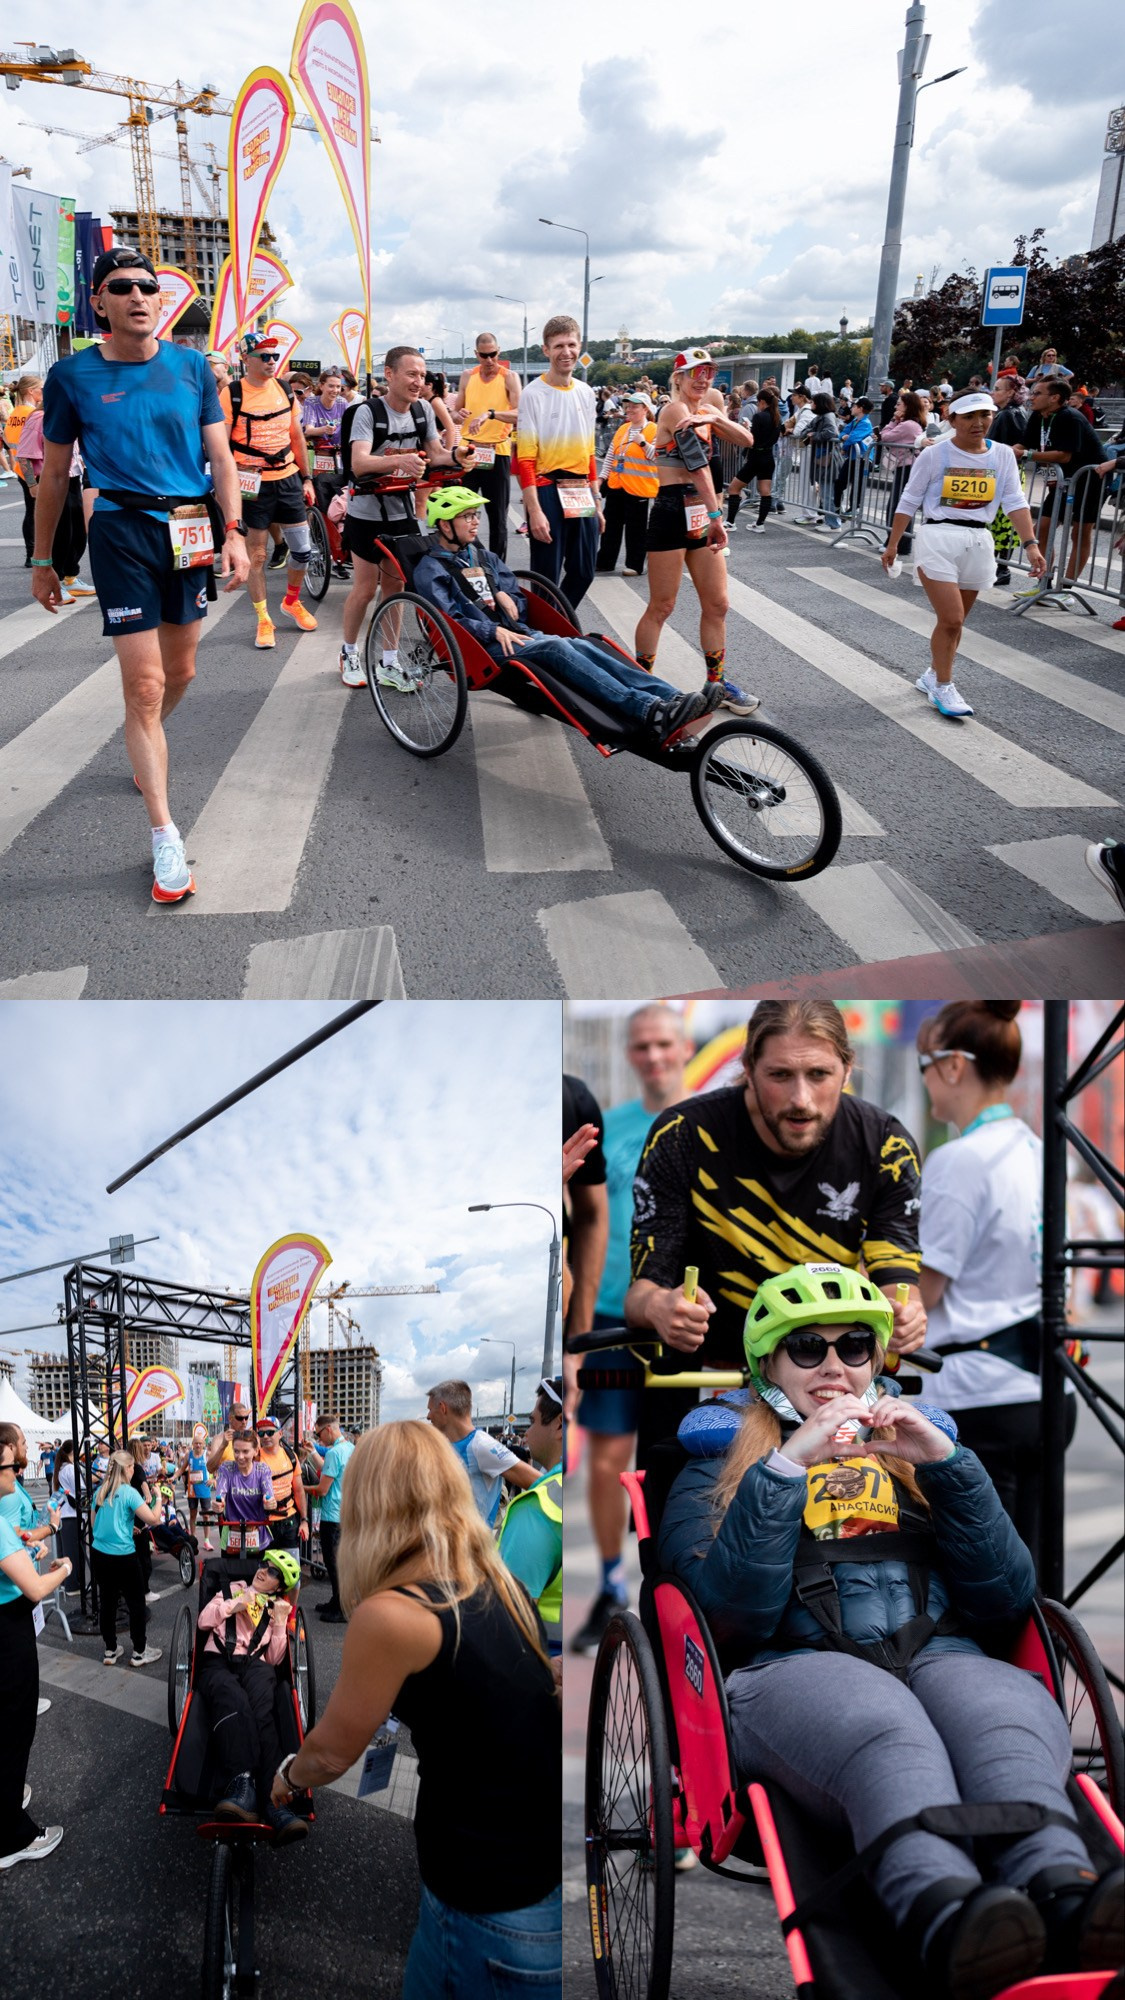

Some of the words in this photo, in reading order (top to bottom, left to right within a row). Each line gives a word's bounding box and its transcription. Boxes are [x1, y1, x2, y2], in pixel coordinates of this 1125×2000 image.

[316, 461, 335, 469] БЕГУН
[951, 480, 988, 493] 5210
[182, 556, 188, 567] B
[268, 1273, 299, 1297] БОЛЬШЕ
[268, 1289, 300, 1312] МОЖЕШЬ
[276, 1287, 291, 1301] ЧЕМ
[830, 1502, 896, 1515] АНАСТАСИЯ
[230, 1537, 256, 1547] БЕГНА
[686, 1653, 702, 1693] 2660
